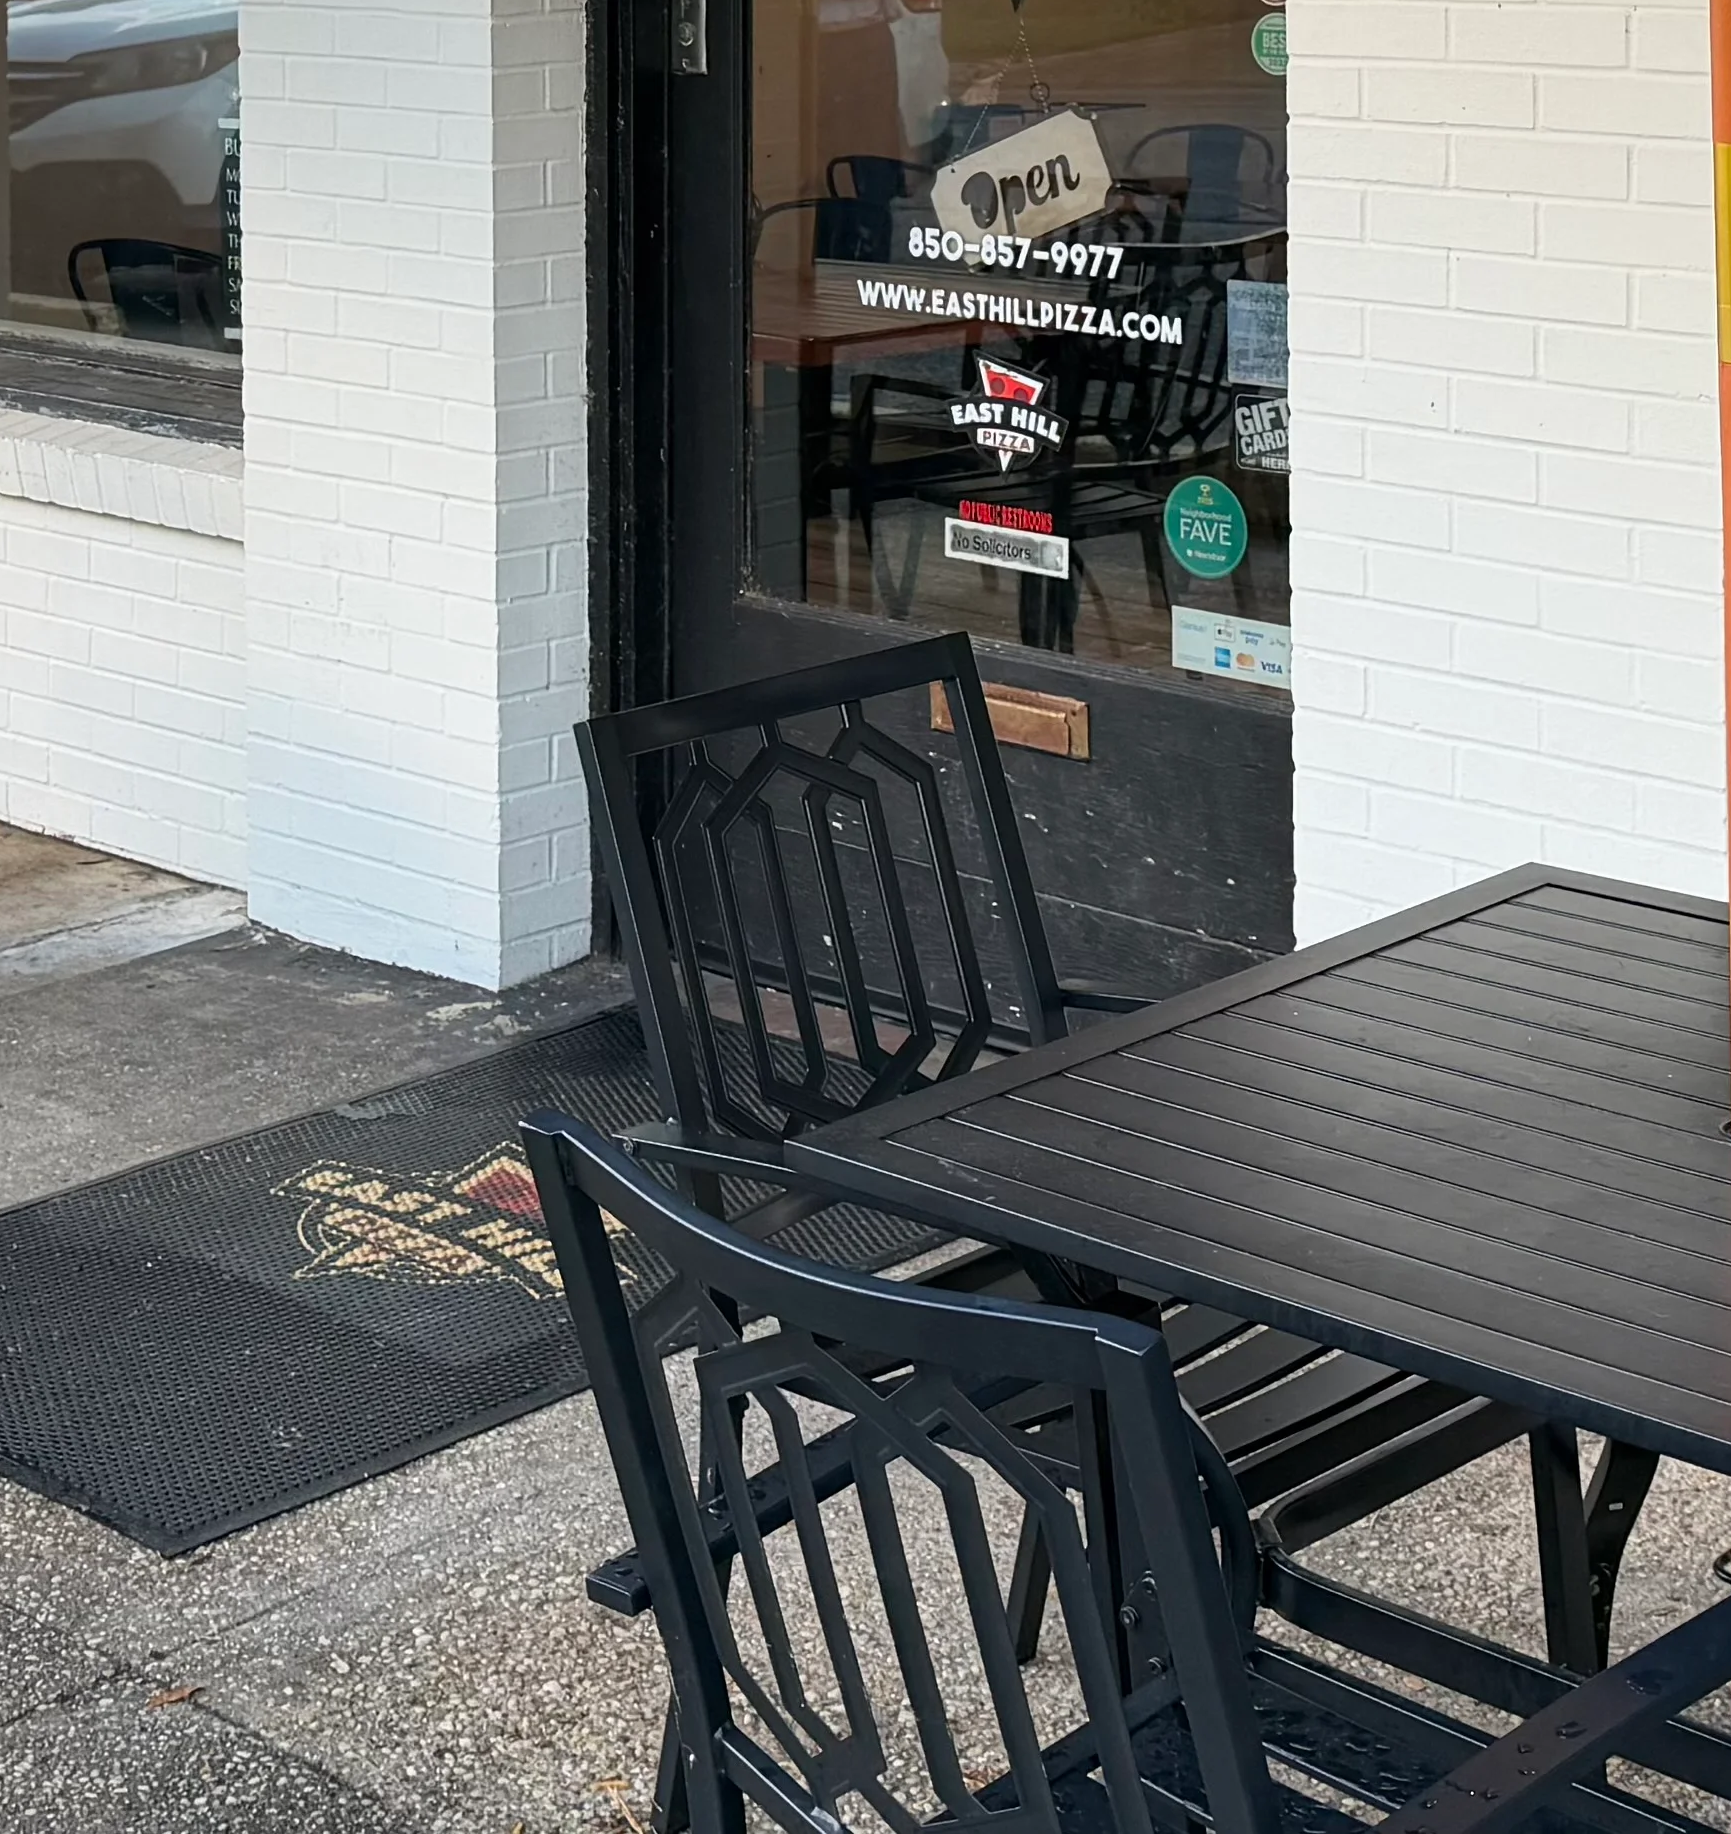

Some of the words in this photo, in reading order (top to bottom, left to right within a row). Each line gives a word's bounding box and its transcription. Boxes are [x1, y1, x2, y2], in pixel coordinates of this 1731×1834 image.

[960, 152, 1081, 234] Open
[908, 226, 1124, 279] 850-857-9977
[856, 278, 1182, 345] WWW.EASTHILLPIZZA.COM
[950, 402, 1004, 425] EAST
[1011, 406, 1060, 444] HILL
[1235, 397, 1289, 437] GIFT
[983, 431, 1030, 450] PIZZA
[1240, 428, 1290, 456] CARD
[1002, 506, 1052, 534] RESTROOMS
[1180, 508, 1231, 521] Neighborhood
[953, 531, 969, 549] No
[973, 535, 1031, 560] Solicitors
[1180, 518, 1231, 546] FAVE
[1261, 661, 1282, 674] VISA
